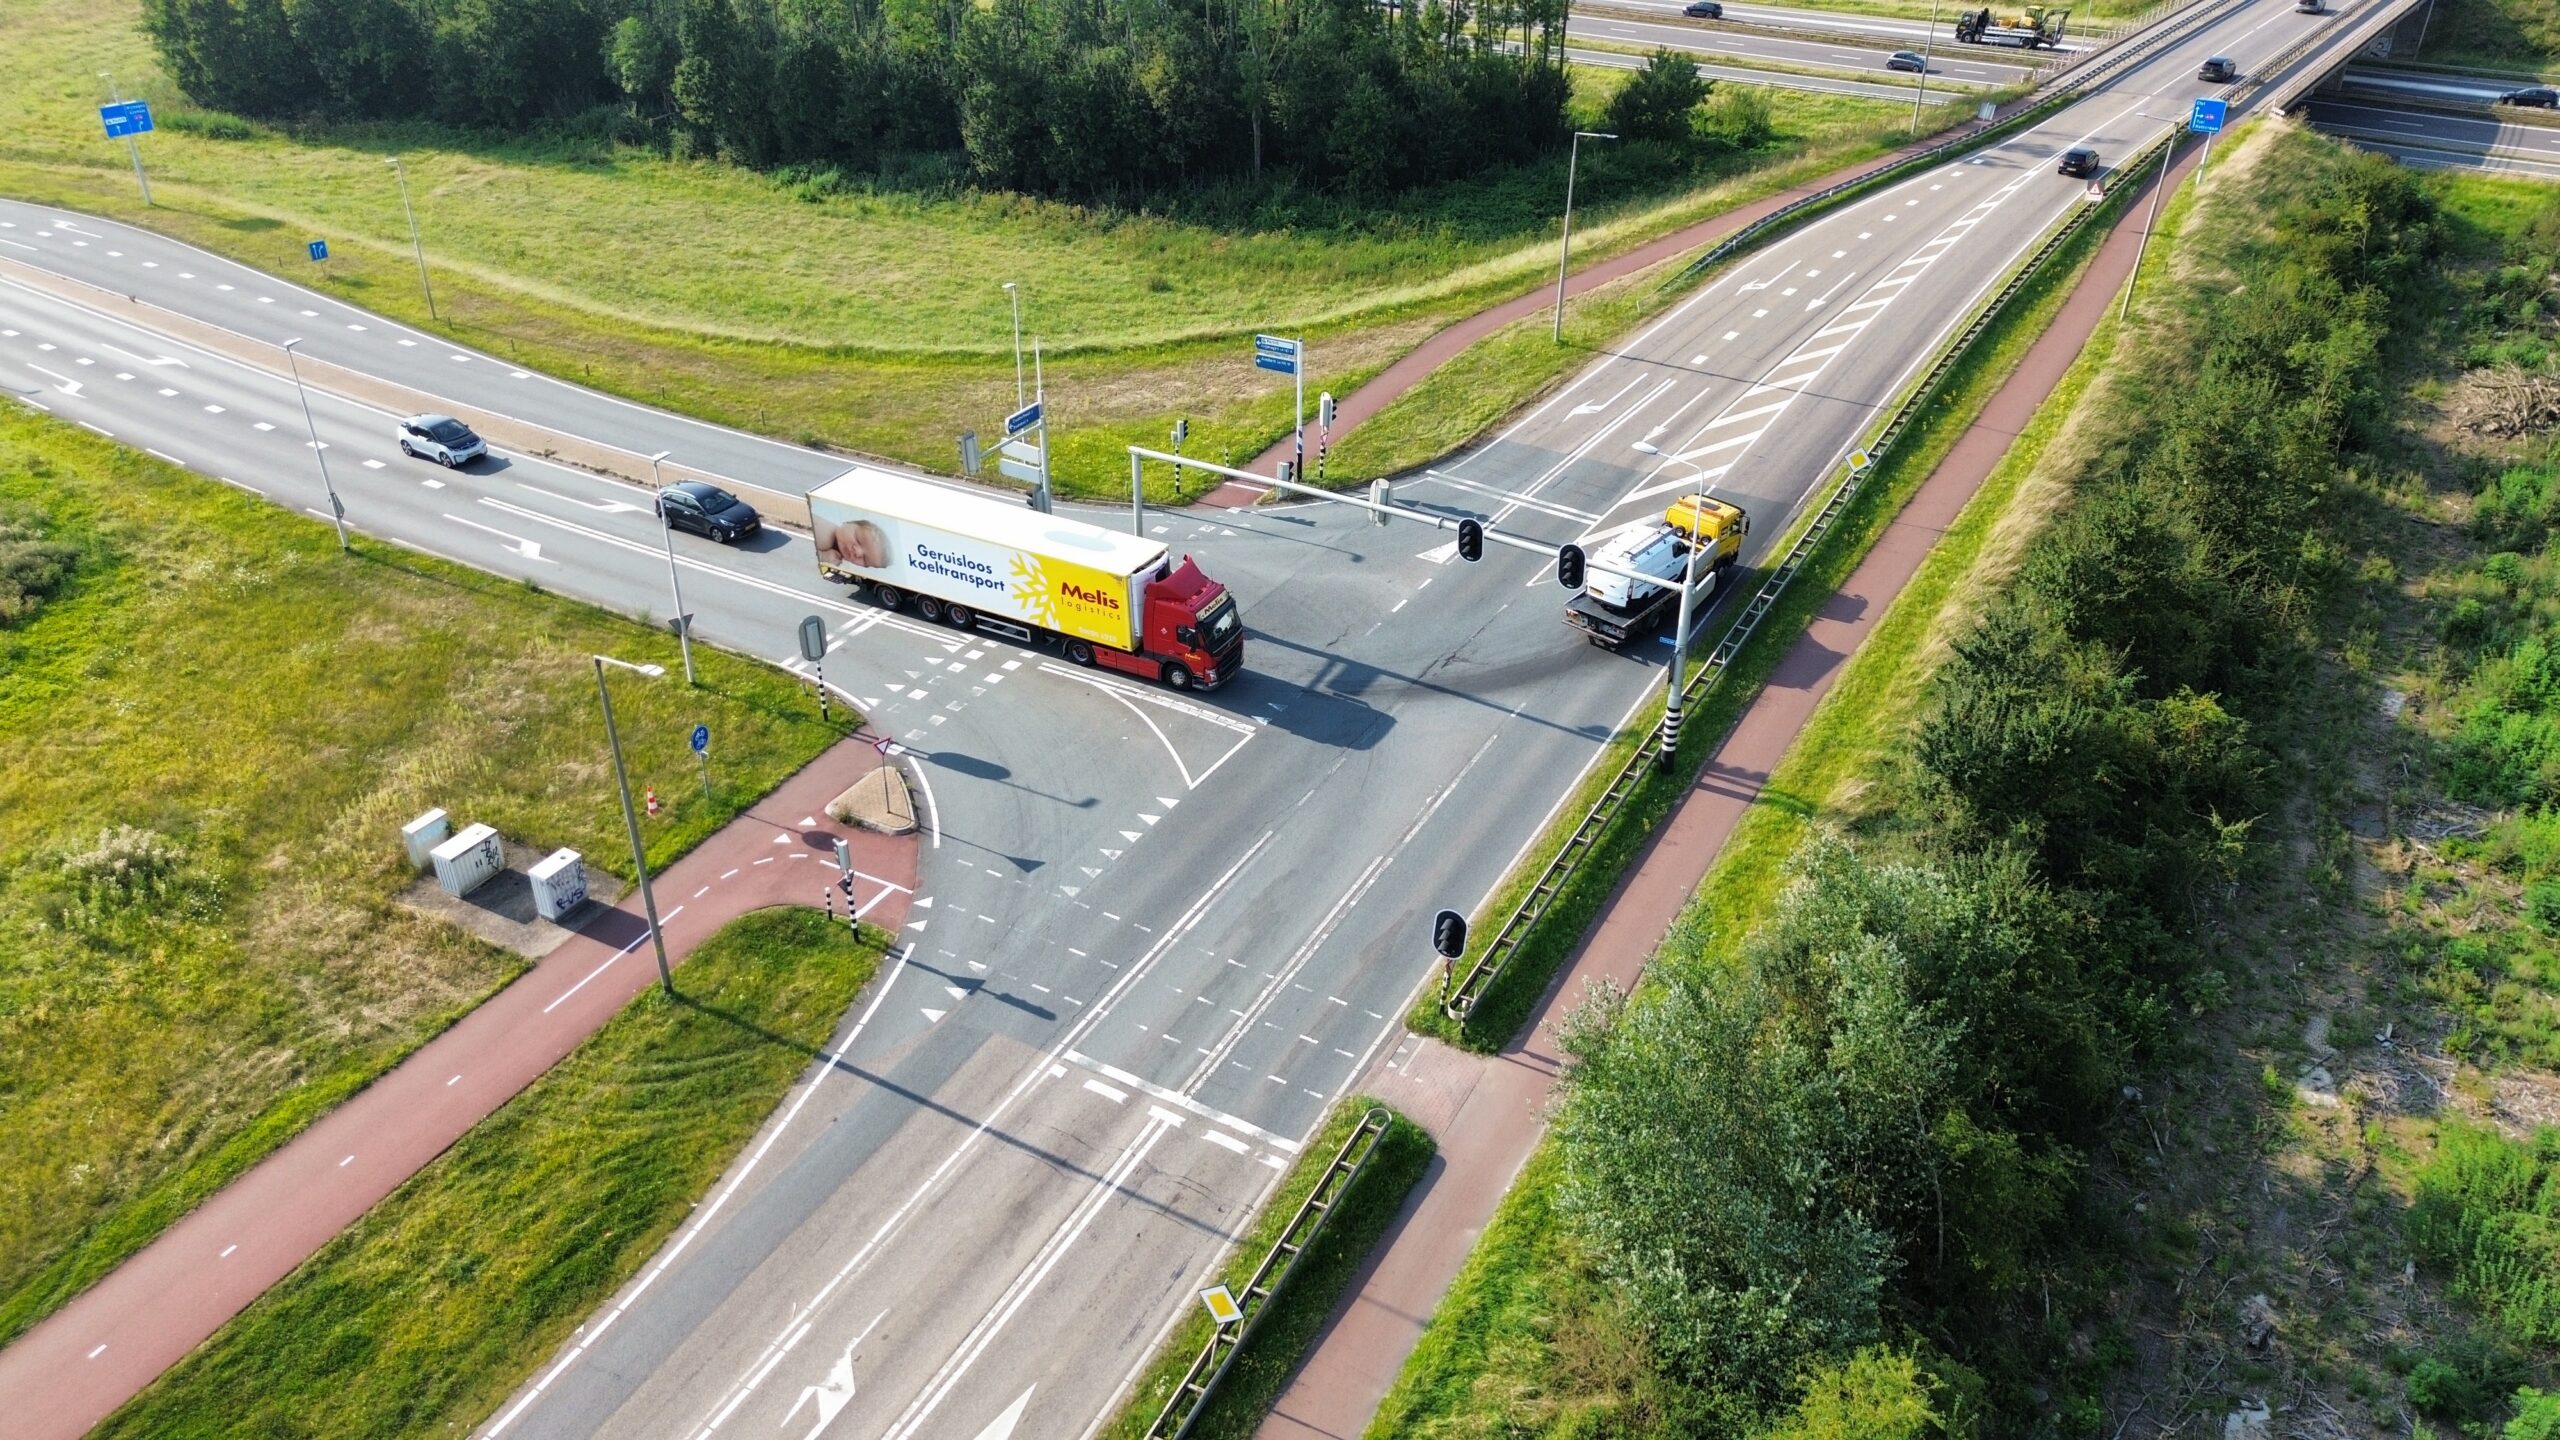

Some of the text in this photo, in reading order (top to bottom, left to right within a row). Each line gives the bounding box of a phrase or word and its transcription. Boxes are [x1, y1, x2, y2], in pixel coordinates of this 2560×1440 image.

[908, 554, 1005, 592] koeltransport
[917, 544, 993, 575] Geruisloos
[1060, 597, 1121, 621] logistics
[1061, 581, 1120, 610] Melis
[1203, 597, 1224, 616] Melis
